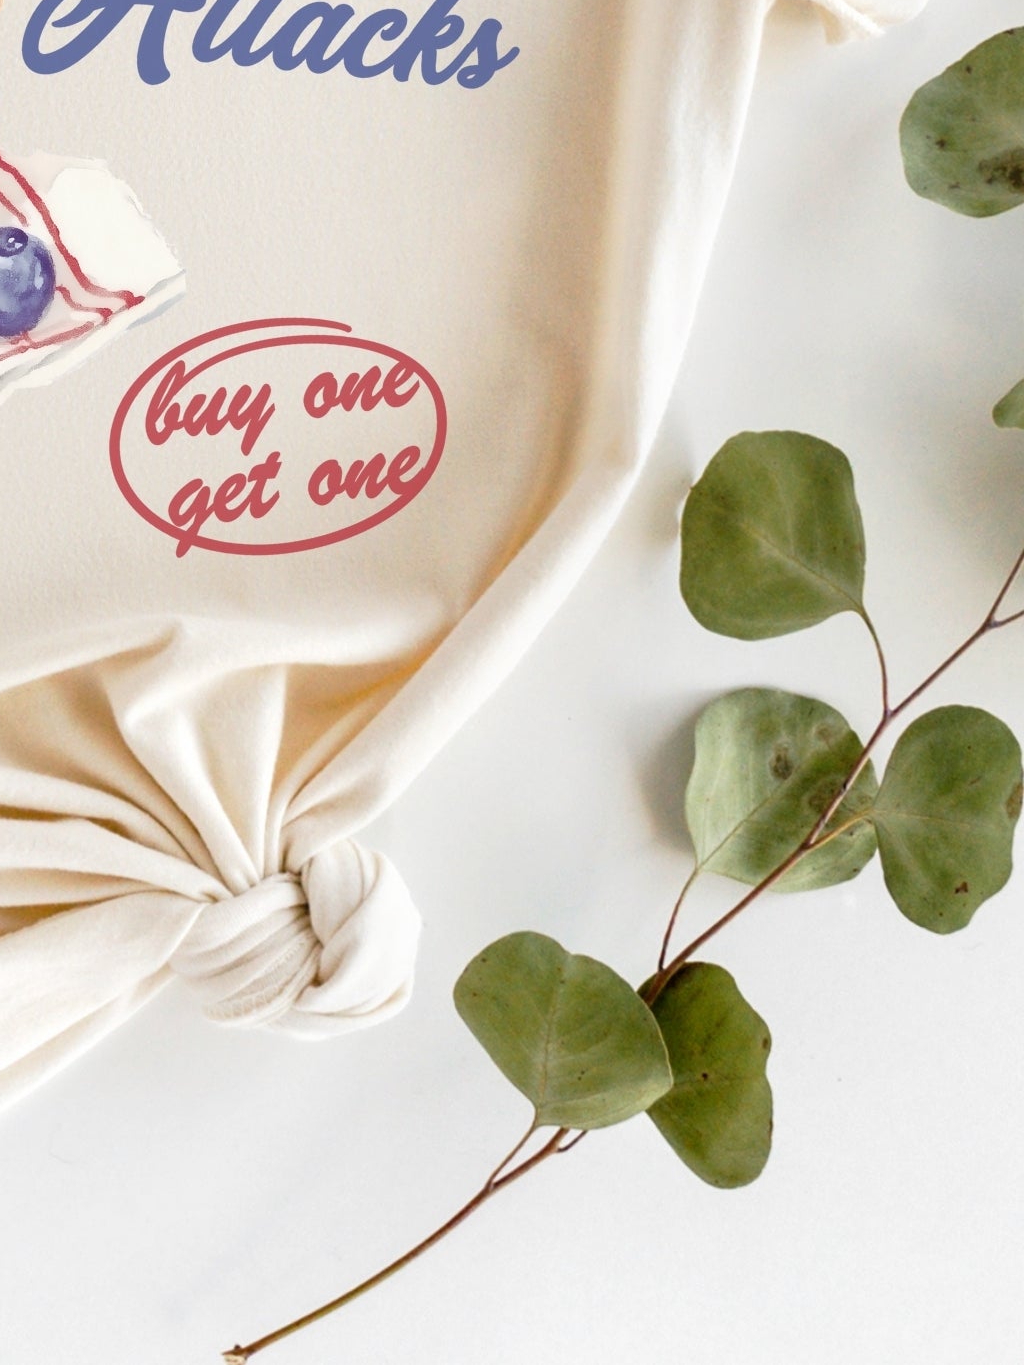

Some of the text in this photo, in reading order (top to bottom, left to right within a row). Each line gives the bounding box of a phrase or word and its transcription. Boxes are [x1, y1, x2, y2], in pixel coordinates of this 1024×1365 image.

[145, 360, 420, 456] buy one
[168, 445, 426, 558] get one
